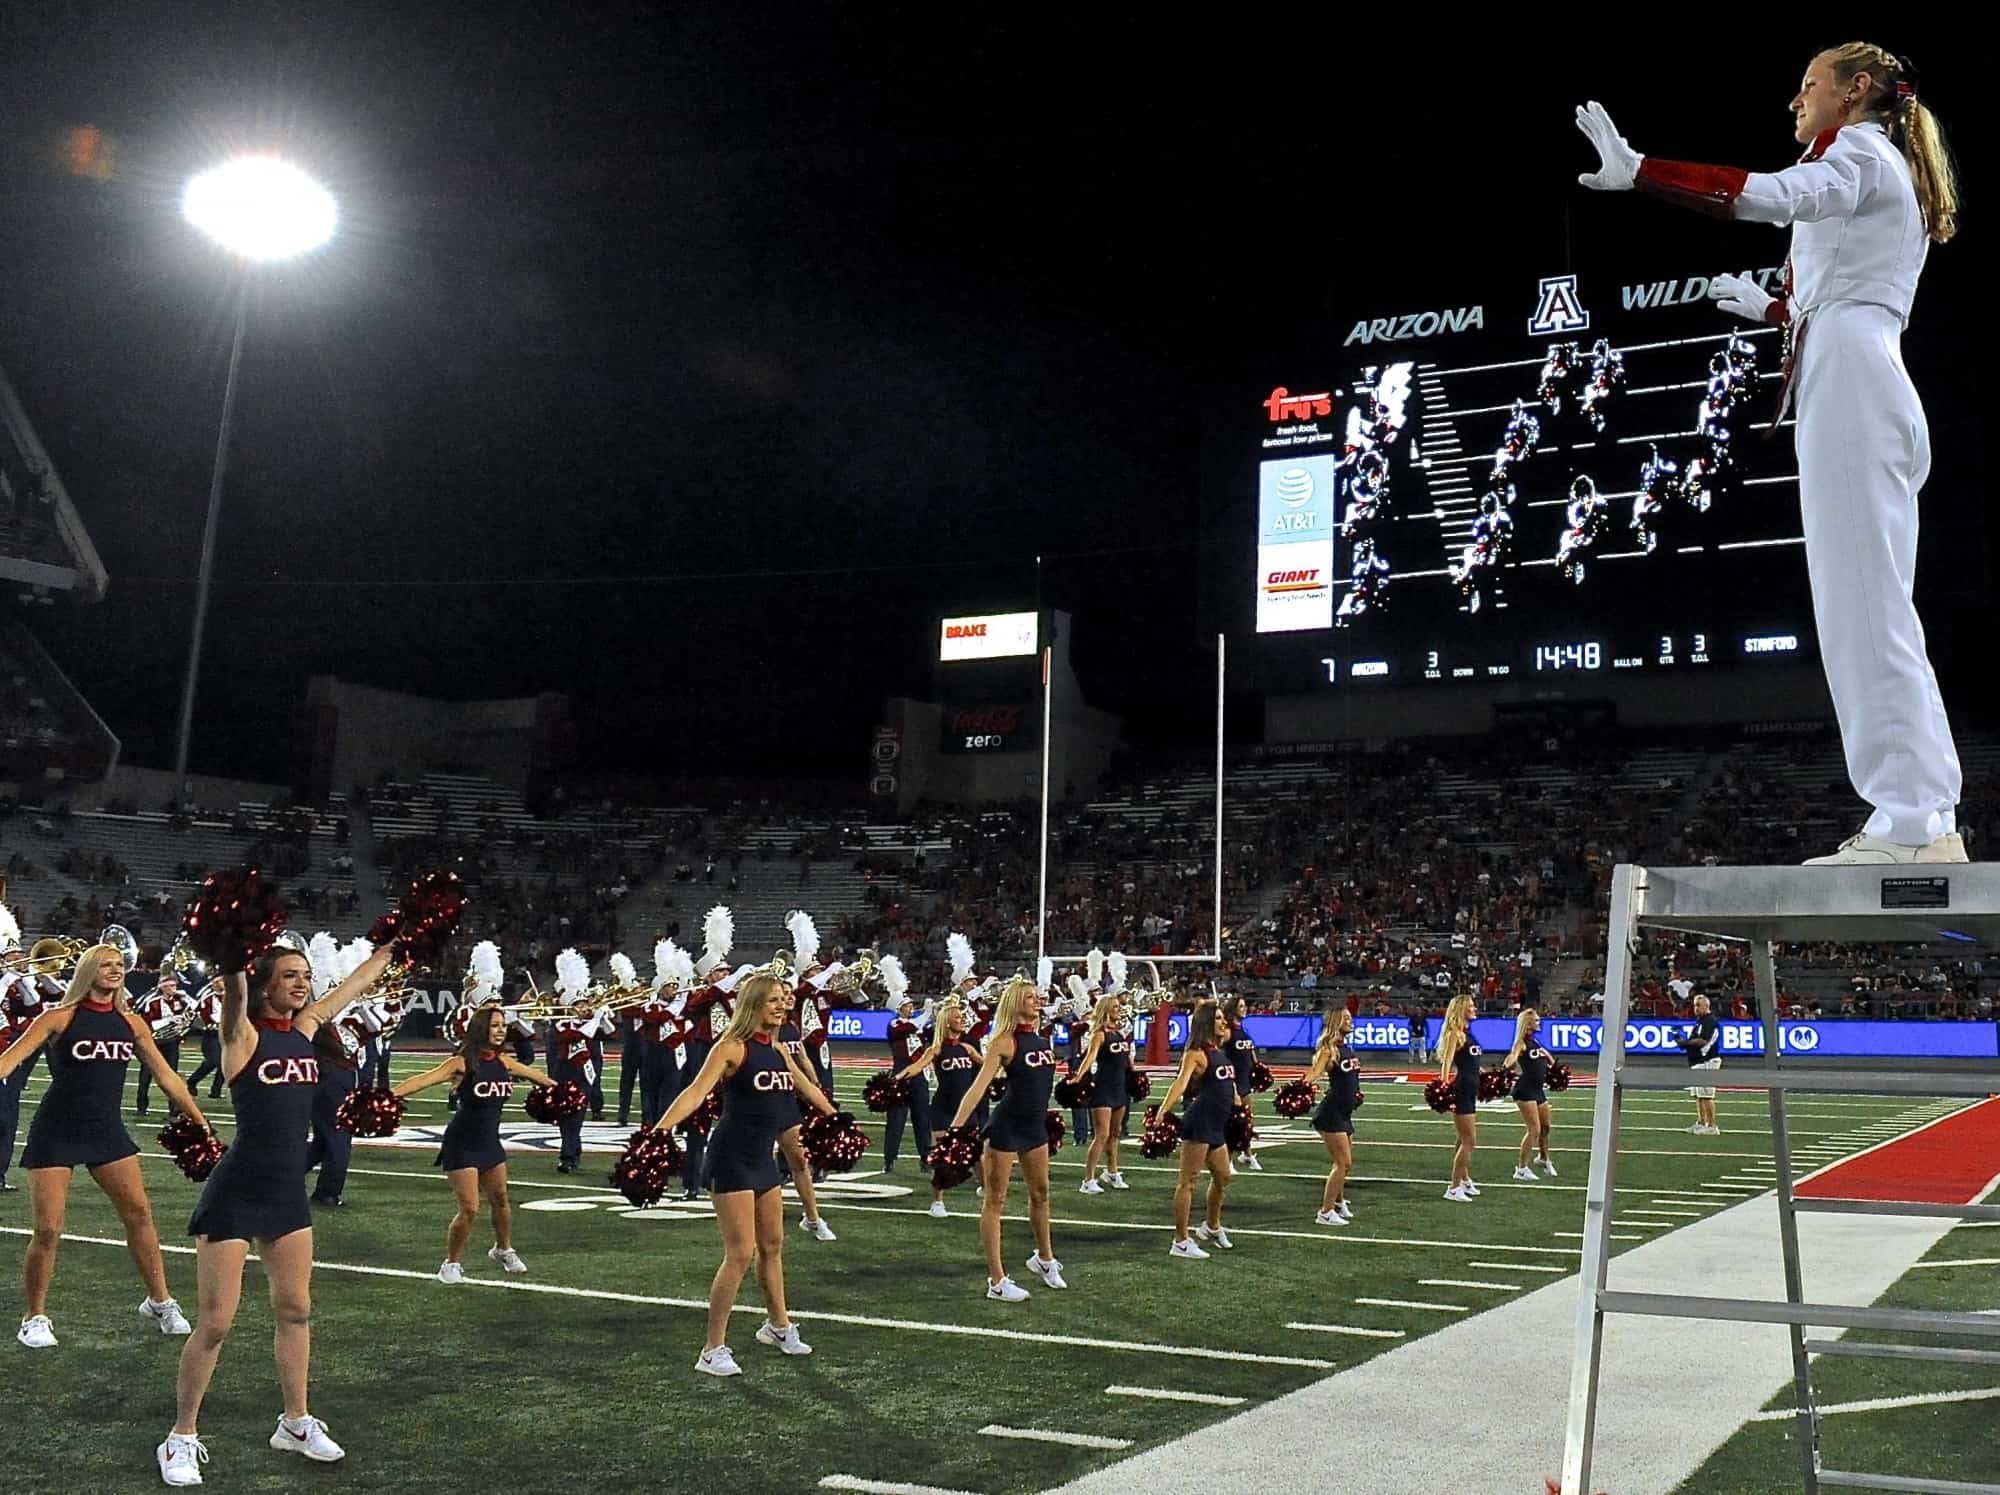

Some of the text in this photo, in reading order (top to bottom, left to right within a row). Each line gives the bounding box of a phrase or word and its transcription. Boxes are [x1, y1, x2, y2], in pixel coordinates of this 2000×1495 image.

[1621, 266, 1788, 312] WILDT
[1528, 274, 1590, 336] A
[1343, 305, 1484, 347] ARIZONA
[1273, 511, 1318, 532] AT&T
[1267, 569, 1319, 584] GIANT
[945, 624, 987, 639] BRAKE
[1661, 636, 1672, 654] 3
[1694, 634, 1706, 652] 3
[1744, 636, 1798, 652] STANFORD
[1427, 651, 1438, 668] 3
[1536, 642, 1600, 670] 14:48
[1320, 658, 1336, 683] 7
[965, 734, 1002, 748] zero
[1289, 1001, 1300, 1012] 12
[1551, 1024, 1592, 1048] IT'S
[1596, 1025, 1678, 1049] OOD
[1723, 1026, 1753, 1049] BE
[71, 1040, 134, 1062] CATS
[1024, 1049, 1056, 1067] CAT
[941, 1056, 973, 1071] CATS
[1215, 1065, 1235, 1080] CAT
